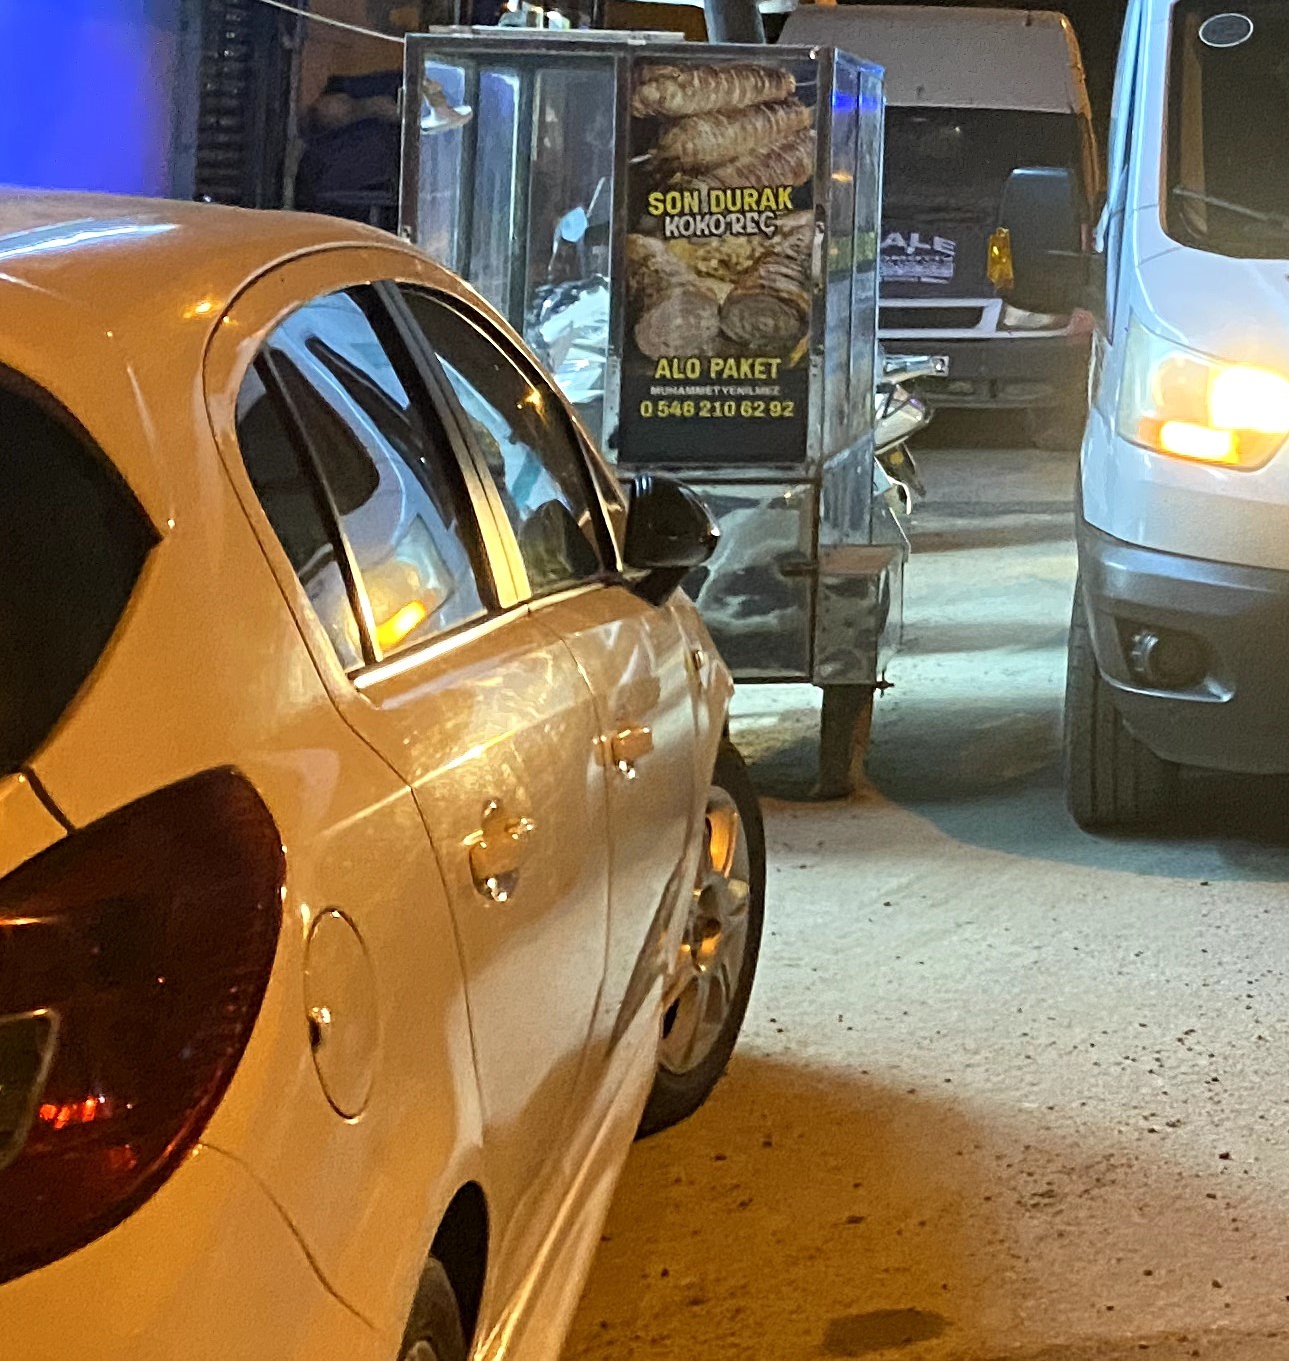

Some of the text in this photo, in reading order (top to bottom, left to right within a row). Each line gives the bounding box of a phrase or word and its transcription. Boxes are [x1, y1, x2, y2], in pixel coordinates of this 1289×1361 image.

[648, 186, 794, 216] SON DURAK
[654, 357, 782, 380] ALO PAKET
[639, 400, 653, 417] 0
[698, 400, 736, 417] 210
[769, 400, 795, 417] 92
